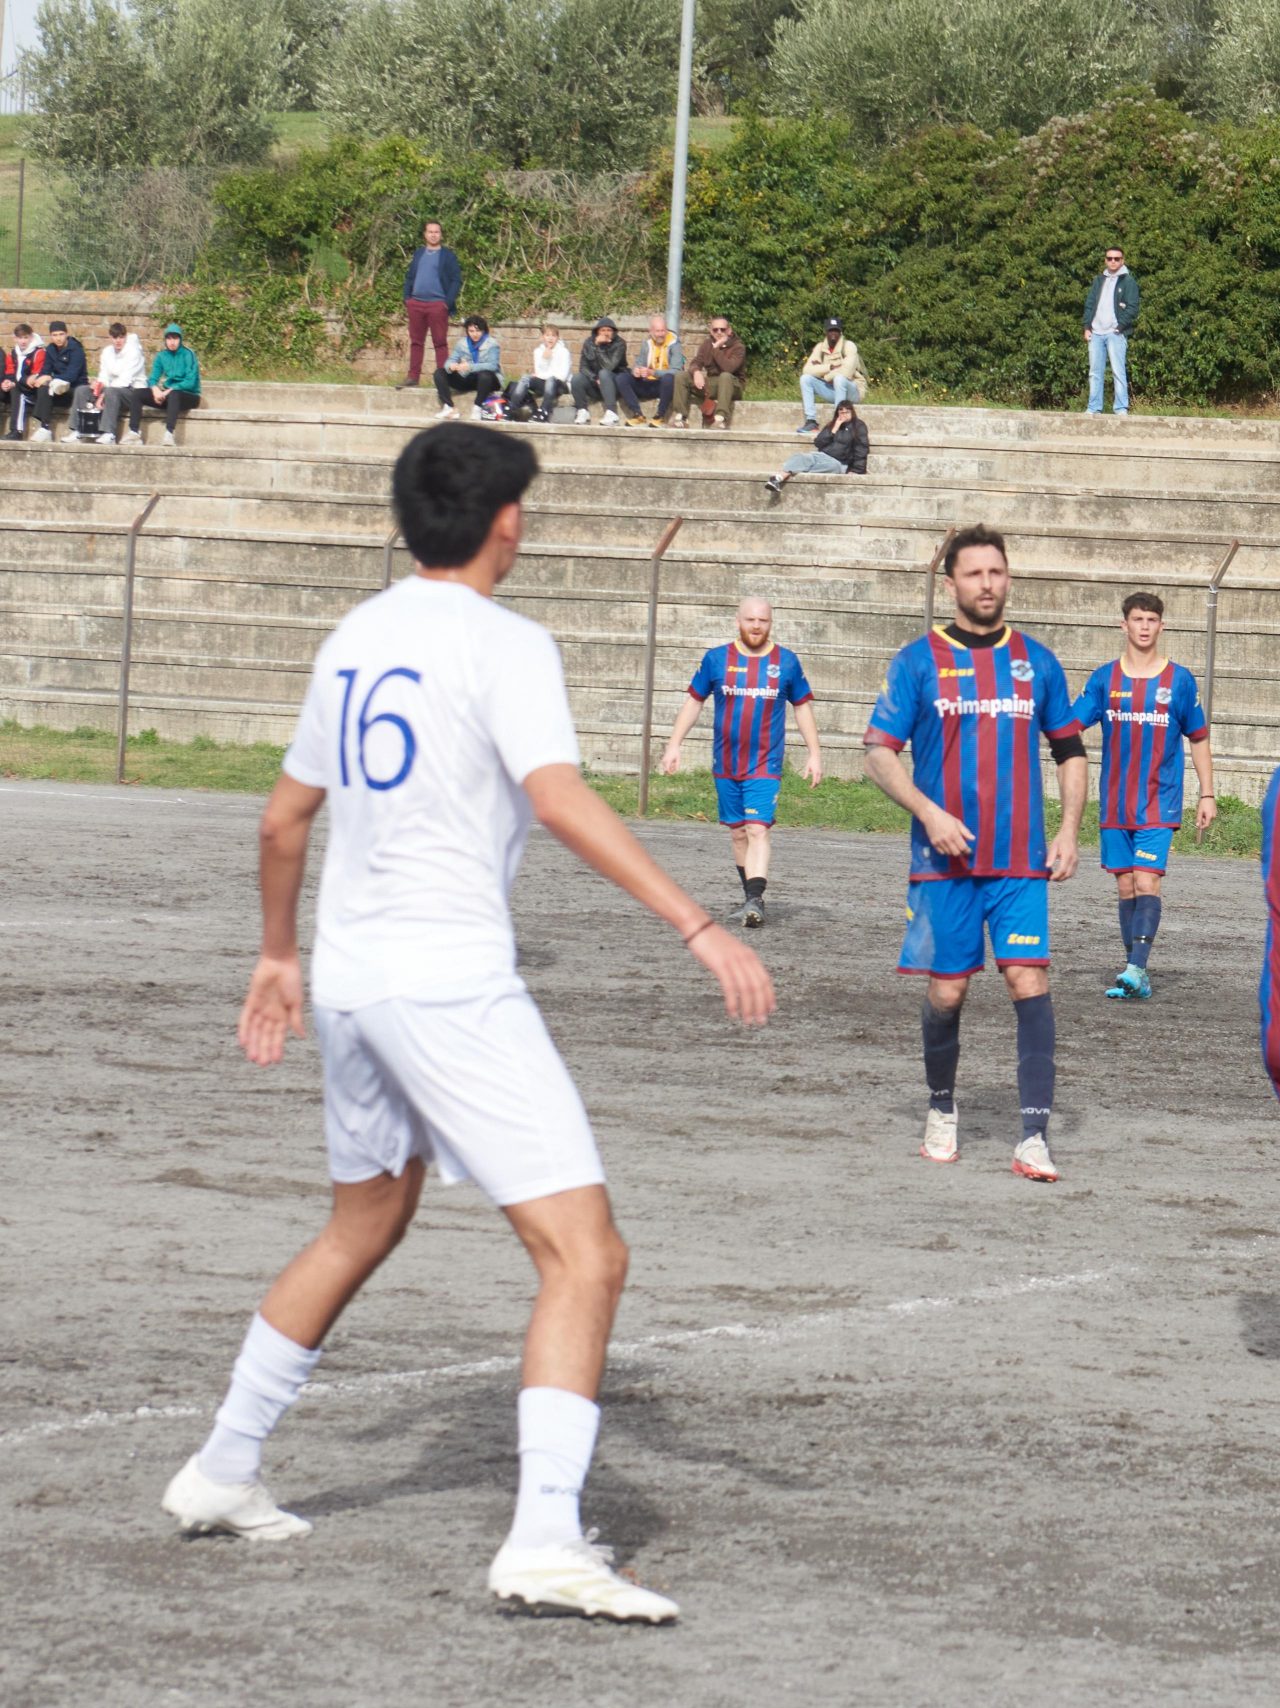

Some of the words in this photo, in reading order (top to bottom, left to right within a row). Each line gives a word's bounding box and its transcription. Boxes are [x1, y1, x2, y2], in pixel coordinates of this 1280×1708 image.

[939, 667, 976, 678] Zeus
[721, 685, 780, 698] Primapaint
[933, 693, 1036, 718] Primapaint
[1105, 709, 1170, 725] Primapaint
[337, 667, 421, 791] 16
[1007, 933, 1040, 945] Zeus
